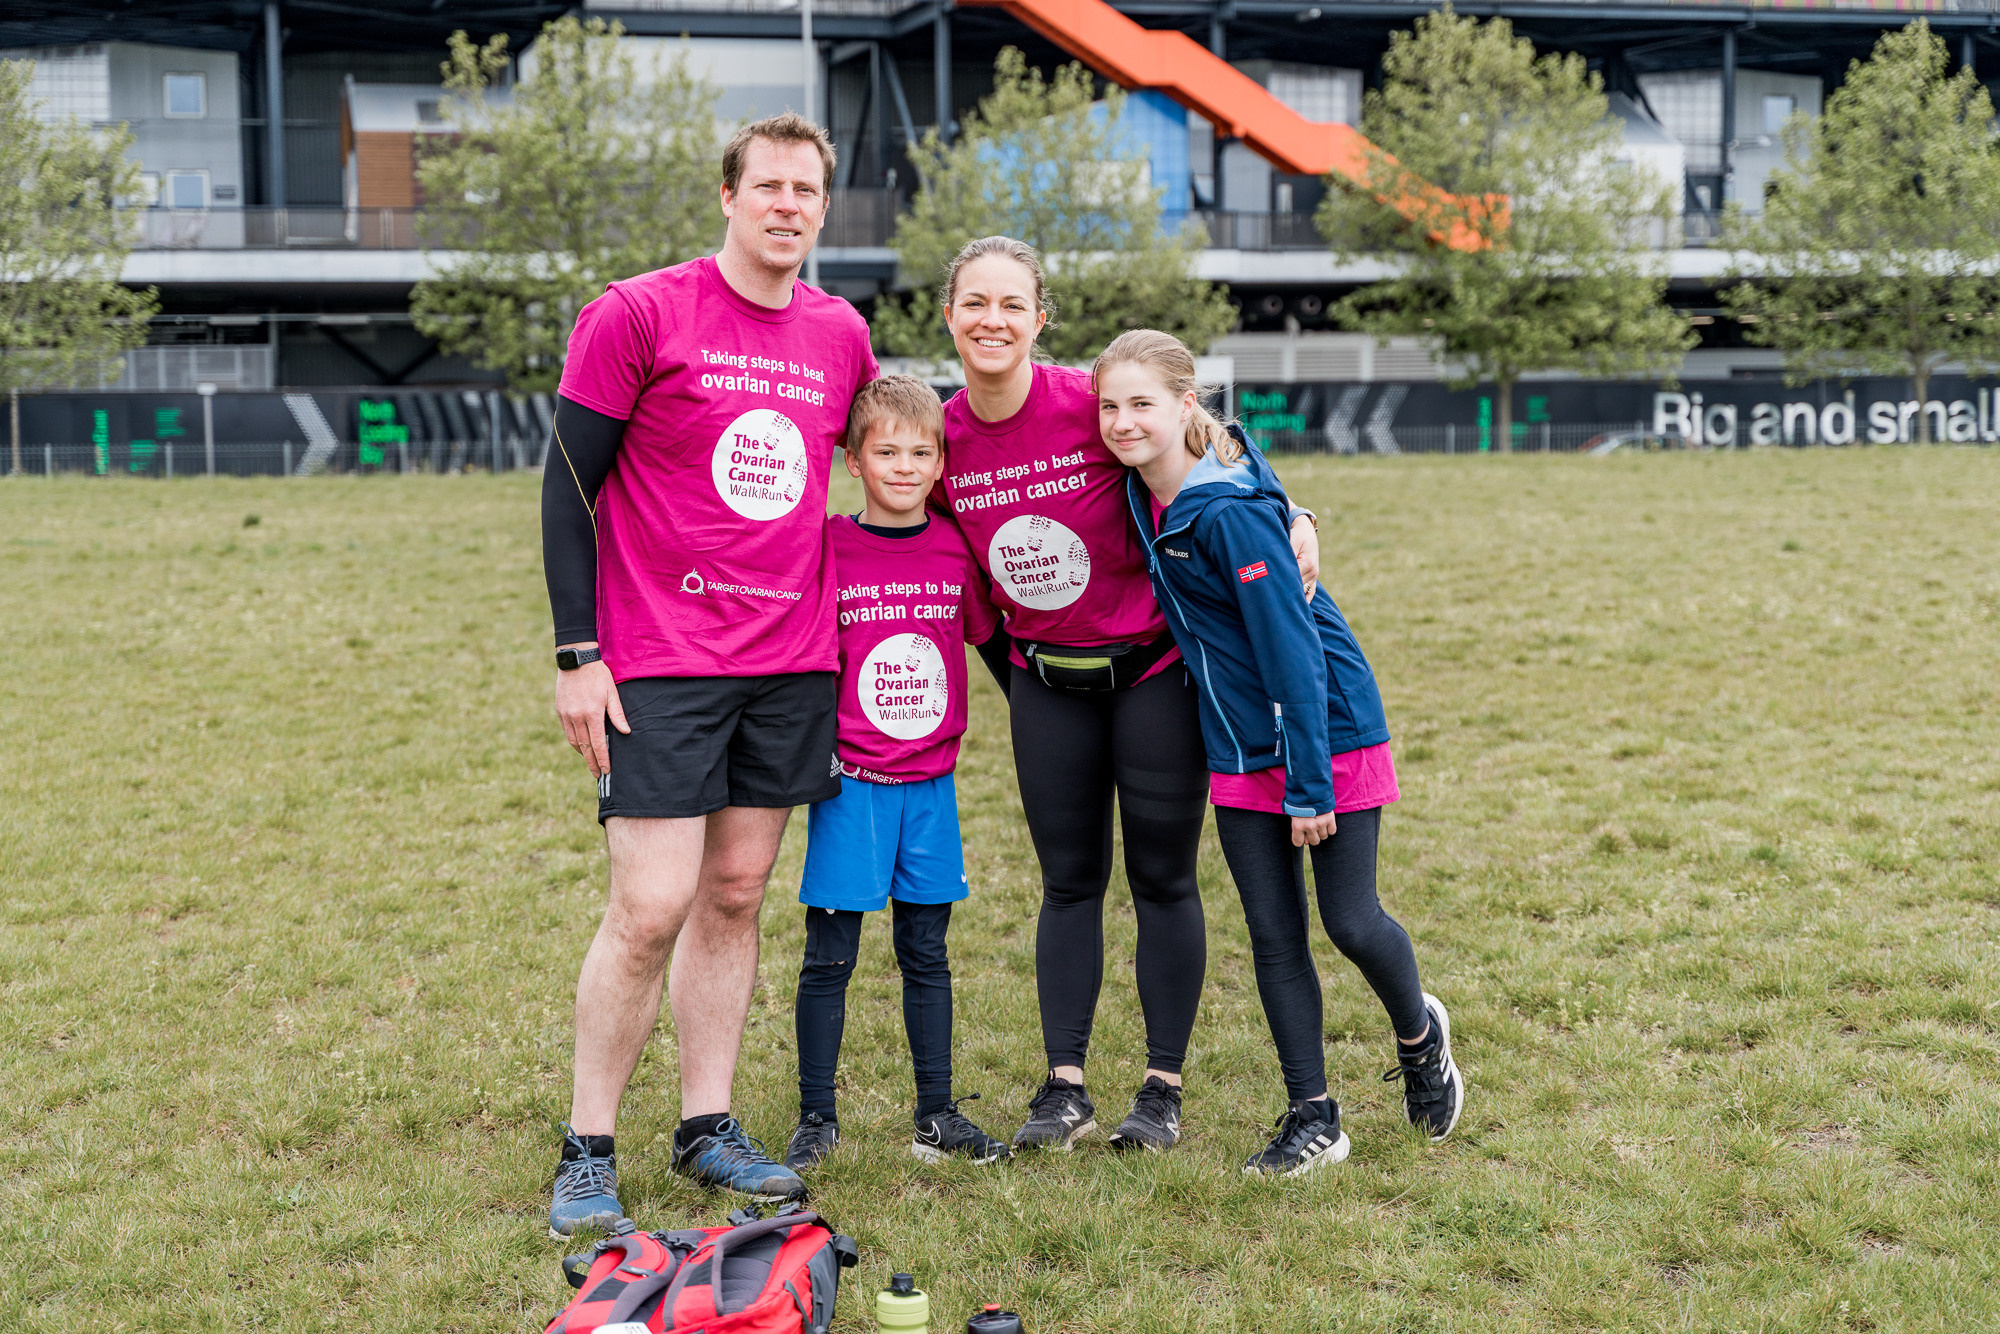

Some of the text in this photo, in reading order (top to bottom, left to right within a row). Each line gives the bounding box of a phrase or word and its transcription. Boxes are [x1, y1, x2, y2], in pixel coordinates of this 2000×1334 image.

[701, 349, 825, 383] Taking steps to beat
[701, 371, 825, 407] ovarian cancer
[1750, 388, 1856, 446] and
[734, 433, 760, 450] The
[731, 450, 785, 470] Ovarian
[728, 467, 778, 486] Cancer
[949, 451, 1086, 489] Taking steps to beat
[955, 472, 1088, 513] ovarian cancer
[998, 545, 1026, 559] The
[1004, 555, 1060, 572] Ovarian
[1010, 569, 1057, 585] Cancer
[707, 581, 739, 593] TARGET
[739, 585, 776, 598] OVARIAN
[884, 582, 921, 598] steps
[925, 581, 939, 594] to
[942, 580, 962, 596] bea
[840, 601, 907, 626] ovarian
[874, 661, 902, 675] The
[875, 676, 929, 691] Ovarian
[875, 693, 925, 707] Cancer
[863, 769, 894, 785] TARGET
